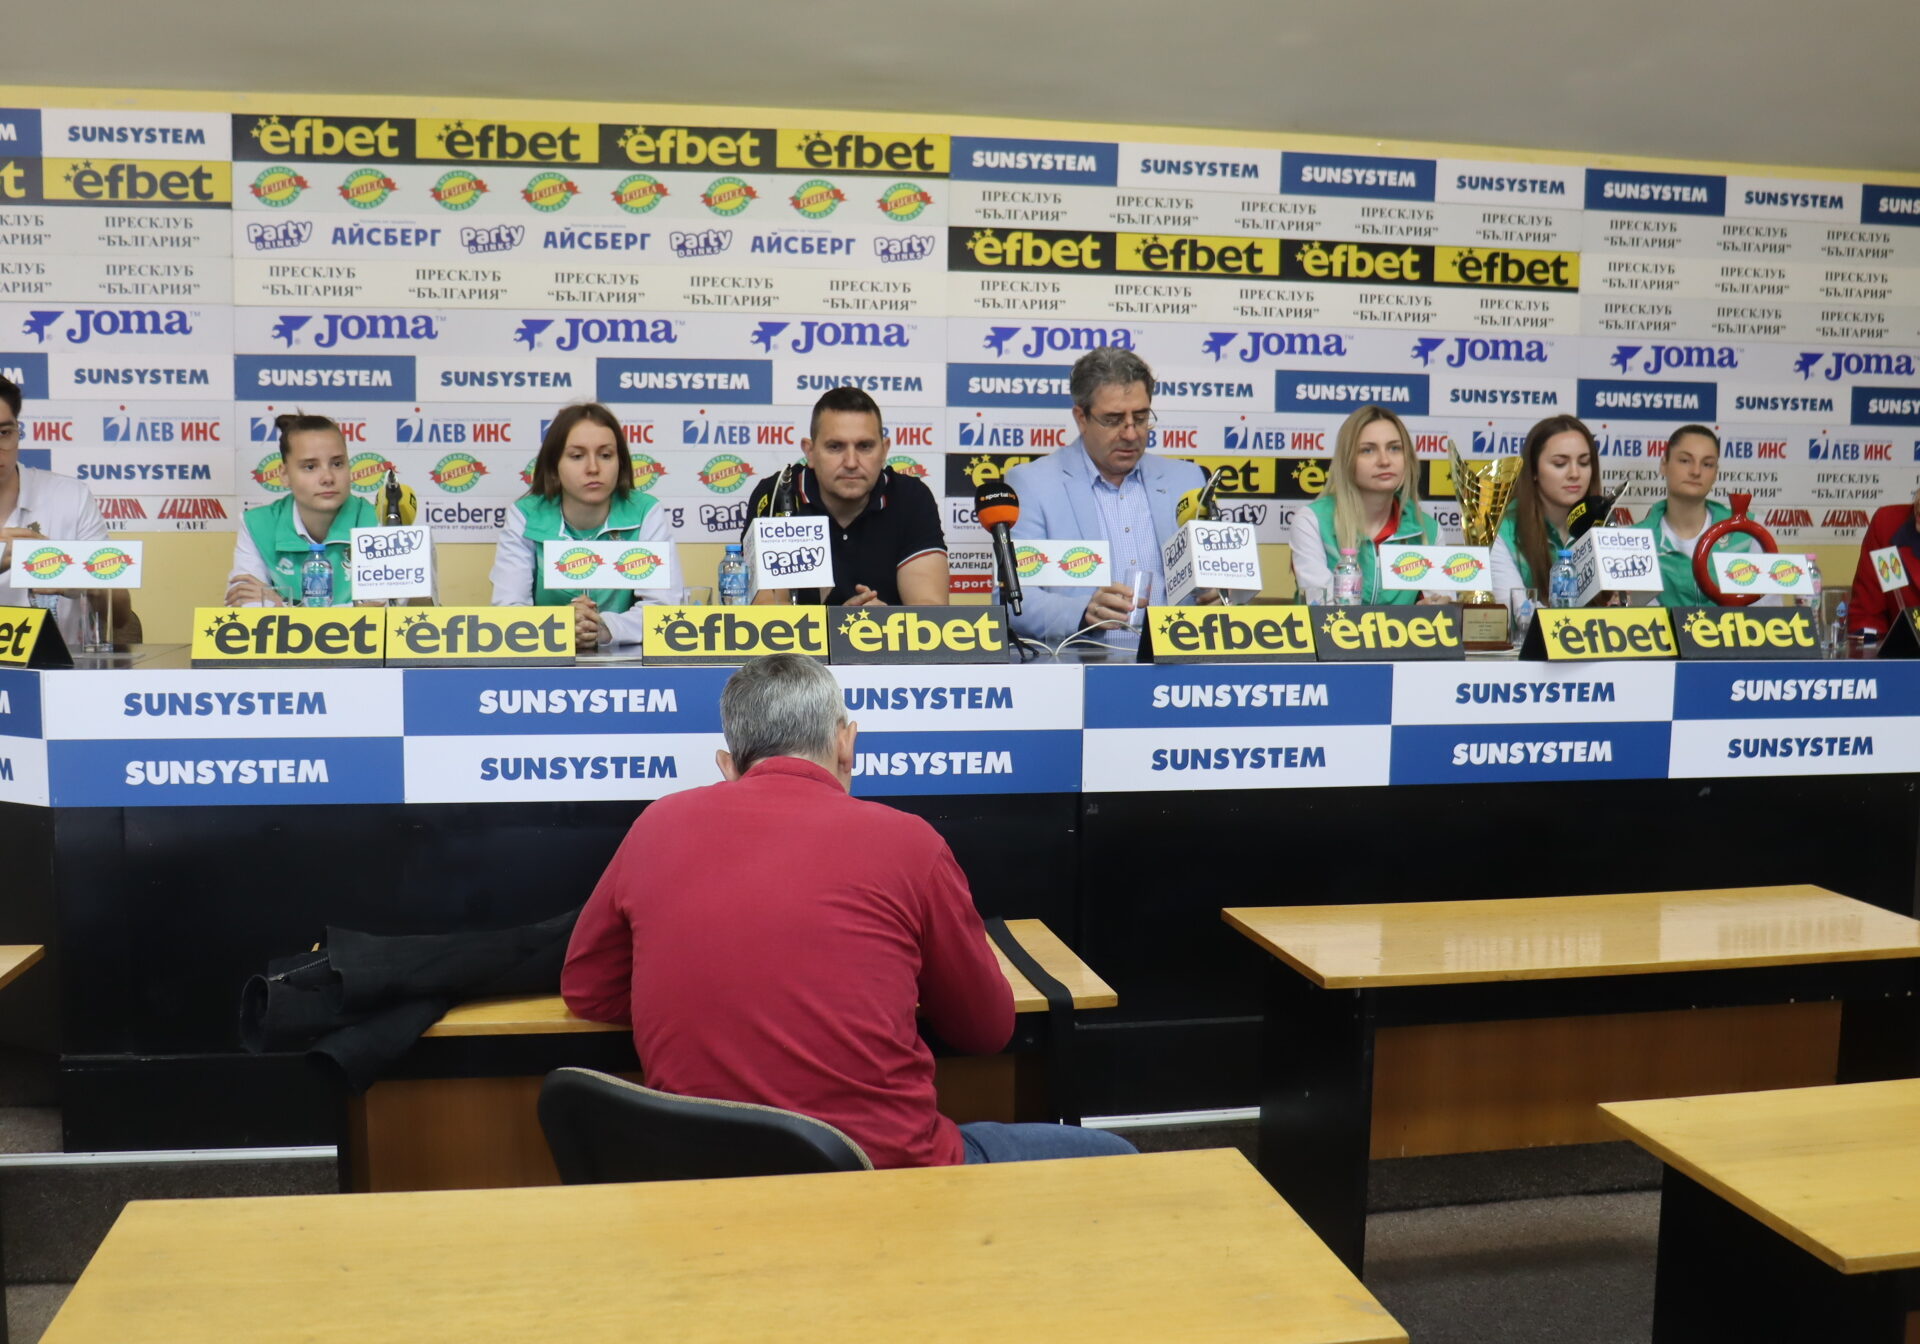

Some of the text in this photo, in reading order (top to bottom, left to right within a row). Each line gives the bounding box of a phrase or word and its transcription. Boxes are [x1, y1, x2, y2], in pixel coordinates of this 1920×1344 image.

[68, 126, 205, 144] SUNSYSTEM
[259, 118, 399, 157] efbet
[445, 124, 580, 161] efbet
[626, 127, 761, 167] efbet
[805, 134, 934, 170] efbet
[972, 151, 1096, 172] SUNSYSTEM
[1140, 159, 1259, 178] SUNSYSTEM
[73, 164, 214, 200] efbet
[1302, 166, 1416, 187] SUNSYSTEM
[1457, 174, 1565, 195] SUNSYSTEM
[982, 190, 1062, 204] ПРЕСКЛУБ
[1604, 181, 1708, 203] SUNSYSTEM
[1744, 190, 1843, 210] SUNSYSTEM
[1116, 196, 1194, 209] ПРЕСКЛУБ
[1241, 200, 1317, 216] ПРЕСКЛУБ
[105, 216, 193, 228] ПРЕСКЛУБ
[1361, 207, 1434, 220] ПРЕСКЛУБ
[1482, 213, 1552, 227] ПРЕСКЛУБ
[247, 221, 312, 245] Party
[331, 224, 441, 246] АЙСБЕРГ
[1609, 219, 1677, 233] ПРЕСКЛУБ
[460, 225, 525, 249] Party
[543, 227, 651, 250] АЙСБЕРГ
[670, 229, 732, 254] Party
[751, 230, 855, 255] АЙСБЕРГ
[1827, 230, 1890, 243] ПРЕСКЛУБ
[874, 235, 935, 258] Party
[974, 232, 1101, 269] efbet
[1141, 239, 1263, 274] efbet
[1302, 245, 1420, 281] efbet
[105, 264, 193, 276] ПРЕСКЛУБ
[269, 265, 356, 279] ПРЕСКЛУБ
[416, 269, 501, 282] ПРЕСКЛУБ
[554, 272, 639, 285] ПРЕСКЛУБ
[1458, 252, 1568, 286] efbet
[690, 276, 773, 289] ПРЕСКЛУБ
[829, 280, 911, 293] ПРЕСКЛУБ
[981, 280, 1060, 293] ПРЕСКЛУБ
[1115, 284, 1192, 297] ПРЕСКЛУБ
[1717, 307, 1782, 320] ПРЕСКЛУБ
[74, 368, 209, 385] SUNSYSTEM
[258, 369, 393, 387] SUNSYSTEM
[441, 371, 572, 387] SUNSYSTEM
[619, 371, 750, 390] SUNSYSTEM
[797, 375, 922, 392] SUNSYSTEM
[969, 377, 1071, 394] SUNSYSTE
[1152, 381, 1254, 397] UNSYSTEM
[1296, 384, 1409, 402] SUNSYSTEM
[1450, 388, 1557, 405] SUNSYSTEM
[1595, 392, 1699, 409] SUNSYSTEM
[1735, 397, 1833, 412] SUNSYSTEM
[33, 422, 73, 441] ИНС
[136, 422, 220, 442] ЛЕВ ИНС
[429, 424, 511, 442] ЛЕВ ИНС
[714, 425, 794, 445] ЛЕВ ИНС
[896, 427, 932, 446] ИНС
[989, 428, 1066, 446] ЛЕВ ИНС
[1164, 430, 1197, 448] ИНС
[1253, 432, 1324, 450] ЛЕВ ИНС
[1416, 435, 1448, 453] ИНС
[1613, 439, 1667, 457] ЛЕВ ИН
[1725, 441, 1787, 459] ЛЕВ ИНС
[1832, 443, 1892, 461] ЛЕВ ИНС
[77, 464, 211, 480] SUNSYSTEM
[1817, 473, 1879, 484] ПРЕСКЛУБ
[426, 502, 506, 528] iceberg
[700, 502, 749, 525] Part
[708, 521, 745, 532] DRINK
[760, 522, 824, 541] iceberg
[358, 530, 423, 553] Party
[1195, 527, 1250, 546] Party
[1597, 532, 1650, 550] iceberg
[763, 546, 825, 569] Party
[949, 552, 993, 560] СПОРТЕН
[949, 561, 993, 569] КАЛЕНДА
[1602, 555, 1652, 574] Party
[358, 565, 424, 583] iceberg
[1198, 556, 1255, 577] iceberg
[215, 614, 378, 655] efbet
[403, 613, 568, 654] efbet
[664, 612, 823, 652] efbet
[848, 611, 1003, 653] efbet
[1170, 611, 1308, 652] efbet
[1338, 610, 1460, 652] efbet
[1559, 617, 1672, 655] efbet
[1691, 610, 1814, 650] efbet
[841, 686, 1013, 710] UNSYSTEM
[1152, 684, 1328, 707] SUNSYSTEM
[1455, 682, 1615, 704] SUNSYSTEM
[1730, 679, 1878, 701] SUNSYSTEM
[123, 691, 327, 717] SUNSYSTEM
[478, 688, 678, 714] SUNSYSTEM
[1452, 741, 1612, 765] SUNSYSTEM
[1727, 736, 1874, 758] SUNSYSTEM
[480, 756, 678, 781] SUNSYSTEM
[850, 751, 1013, 776] UNSYSTEM
[1151, 748, 1326, 770] SUNSYSTEM
[125, 759, 329, 786] SUNSYSTEM
